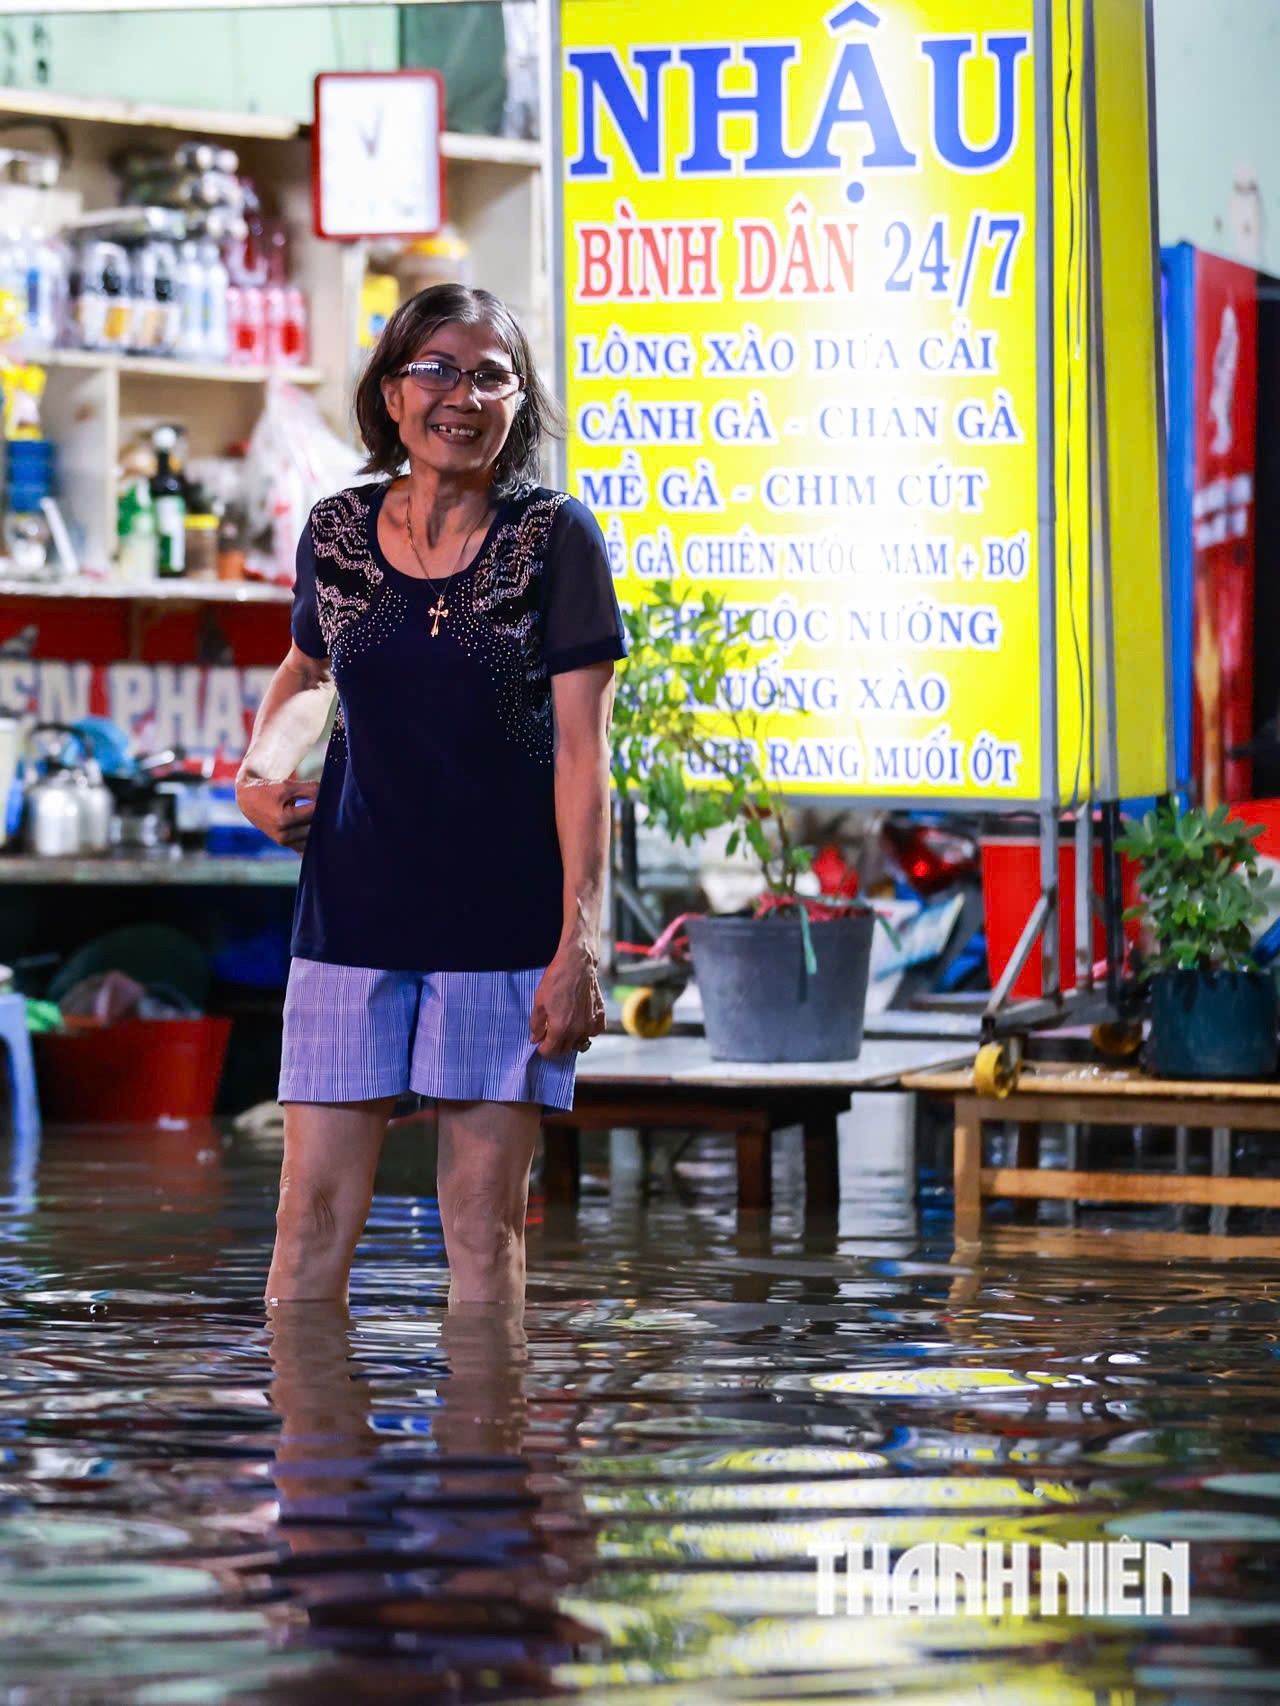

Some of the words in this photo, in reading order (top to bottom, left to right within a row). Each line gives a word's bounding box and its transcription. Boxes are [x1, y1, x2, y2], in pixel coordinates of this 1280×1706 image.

[569, 1, 1027, 203] NHẬU
[580, 204, 716, 298] BÌNH
[740, 201, 859, 295] DÂN
[884, 215, 1020, 308] 24/7
[581, 330, 690, 373] LÒNG
[709, 328, 794, 372] XÀO
[814, 332, 900, 371] DƯA
[581, 397, 695, 440] CÁNH
[715, 396, 771, 440] GÀ
[958, 394, 1018, 438] GÀ
[581, 453, 642, 507] MỀ
[662, 464, 719, 507] GÀ
[766, 475, 877, 507] CHIM
[898, 464, 984, 507] CÚT
[605, 520, 625, 574] Ề
[636, 531, 675, 574] GÀ
[686, 531, 774, 574] CHIÊN
[849, 601, 997, 645] NƯỚNG
[860, 667, 945, 711] XÀO
[770, 744, 858, 776] RANG
[875, 729, 958, 780] MUỐI
[973, 737, 1016, 780] ỚT
